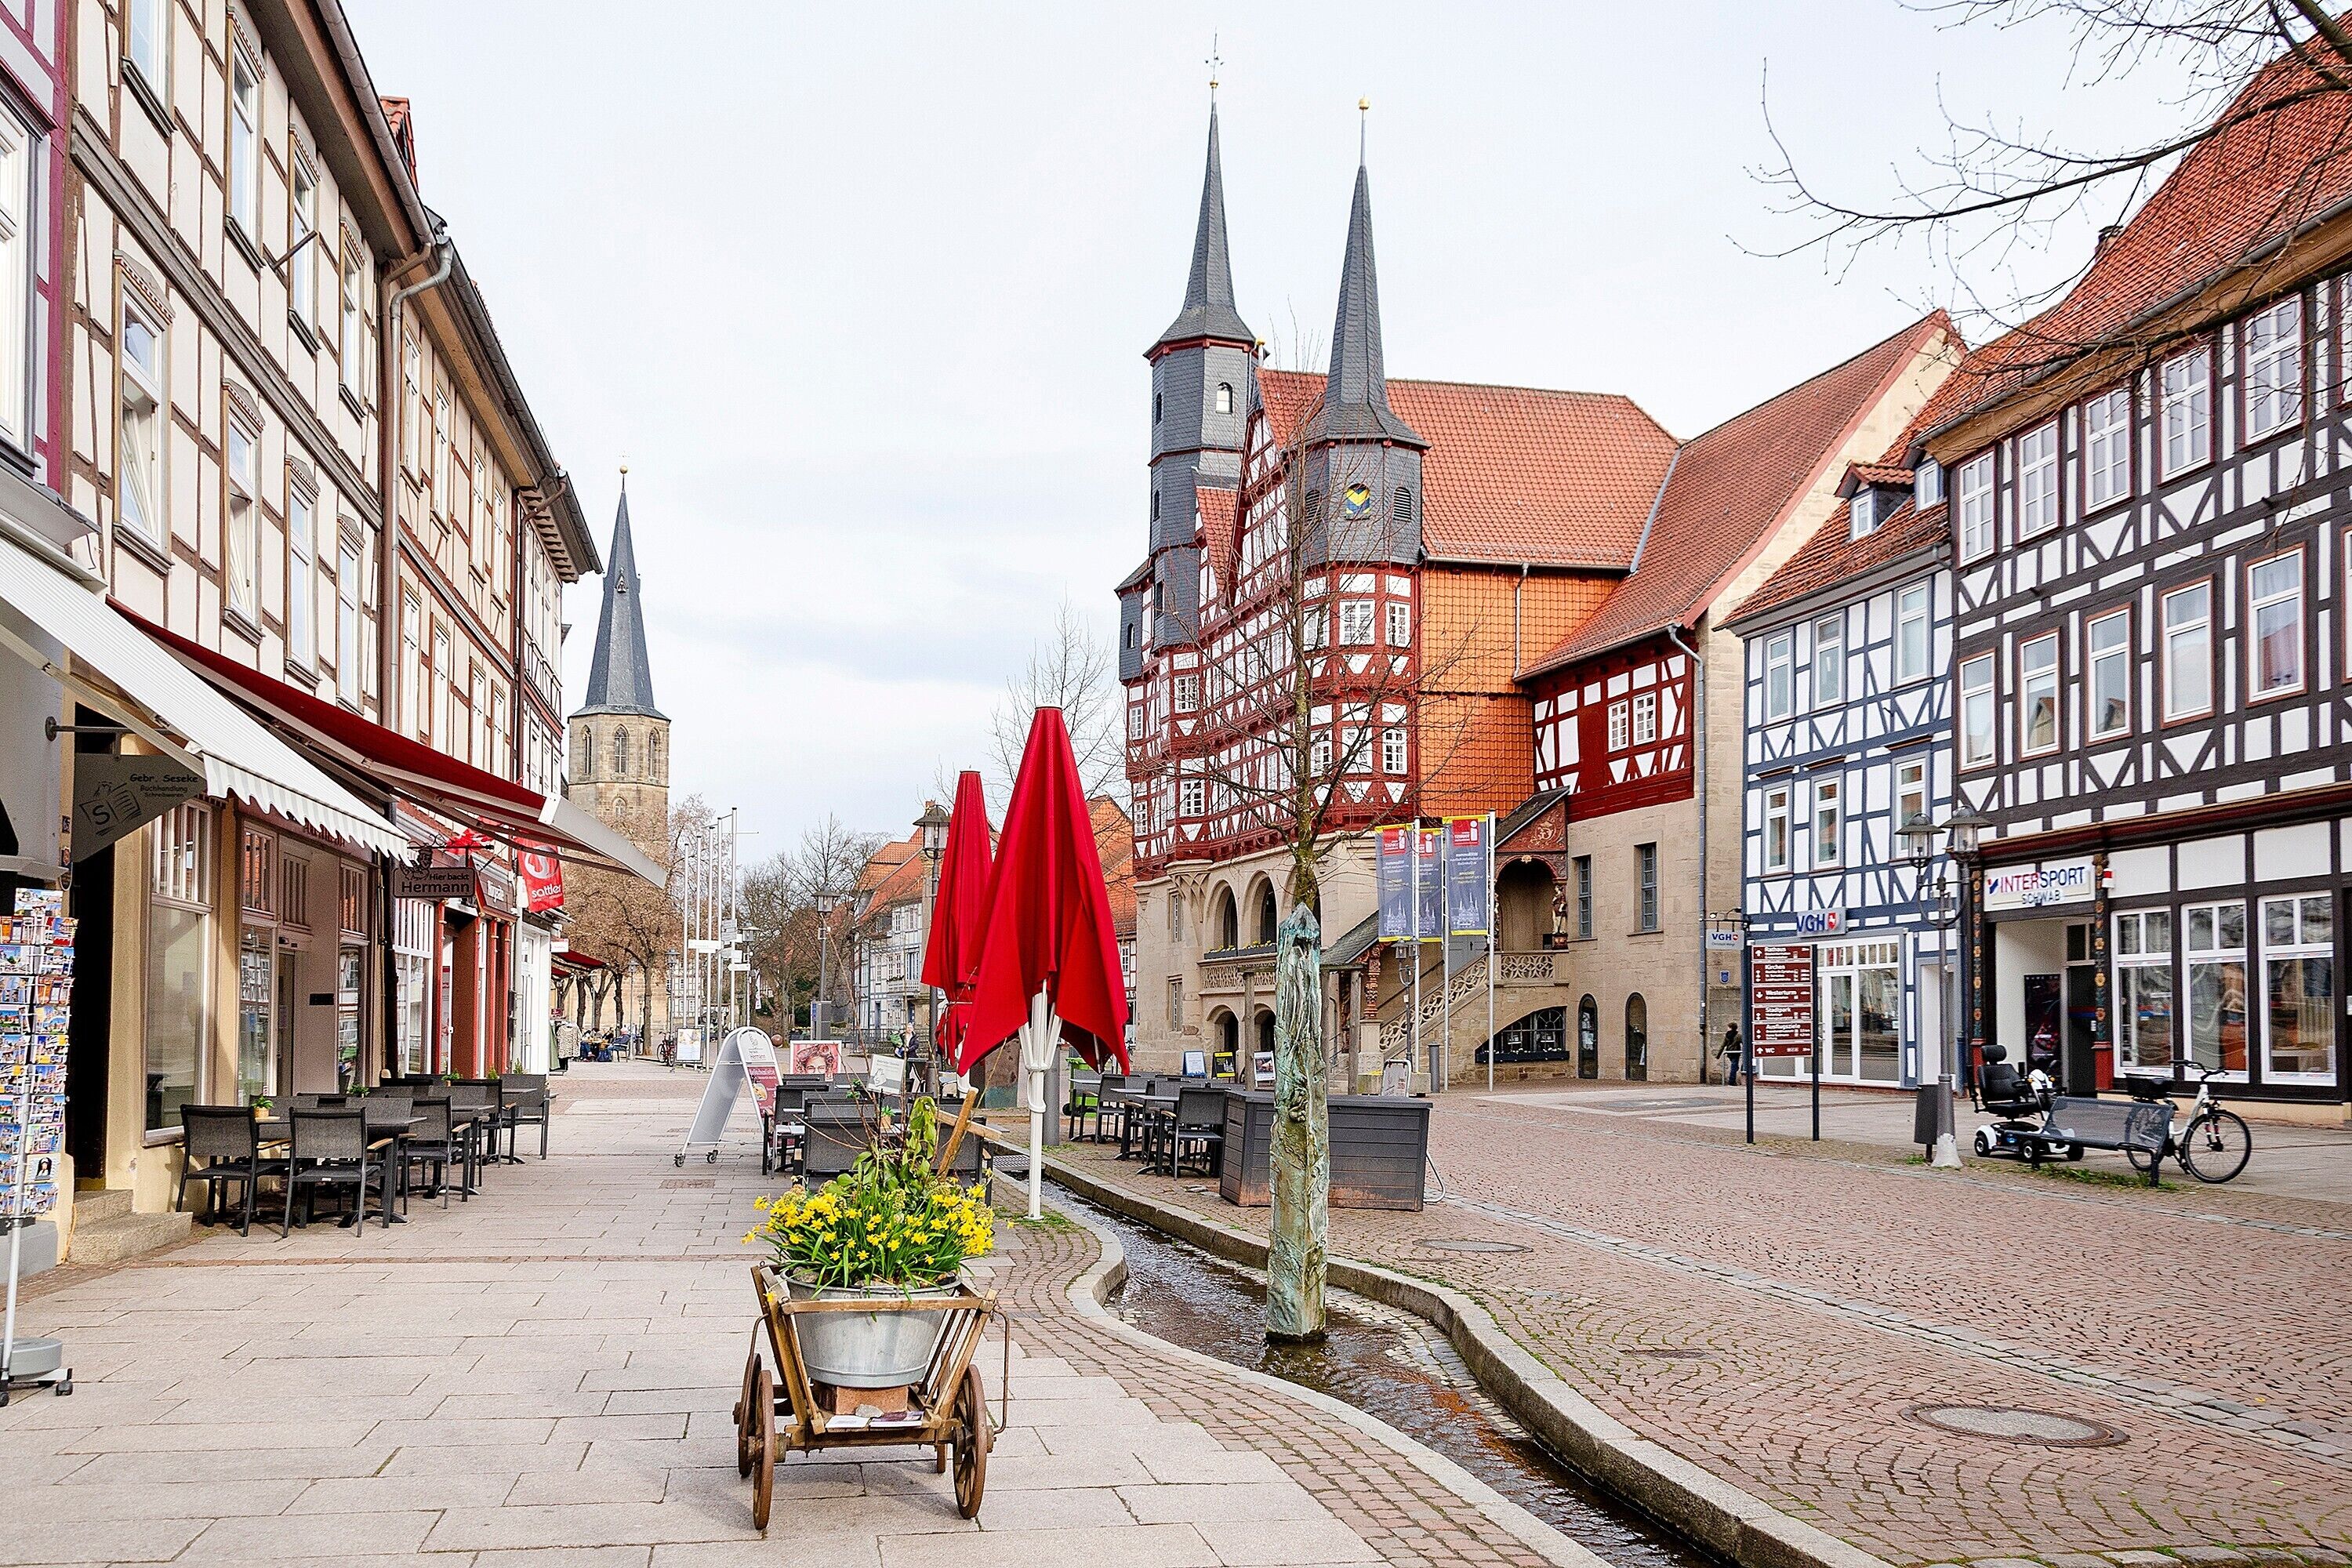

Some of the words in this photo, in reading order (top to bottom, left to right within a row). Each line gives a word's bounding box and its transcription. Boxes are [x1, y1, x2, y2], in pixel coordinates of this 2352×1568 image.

[129, 773, 158, 782] Gebr.
[162, 774, 198, 782] Seseke
[92, 804, 111, 824] S
[401, 880, 470, 893] Hermann
[2000, 866, 2085, 893] INTERSPORT
[531, 883, 562, 898] sattler
[2021, 889, 2061, 905] SCHWAB
[1796, 913, 1825, 932] VGH
